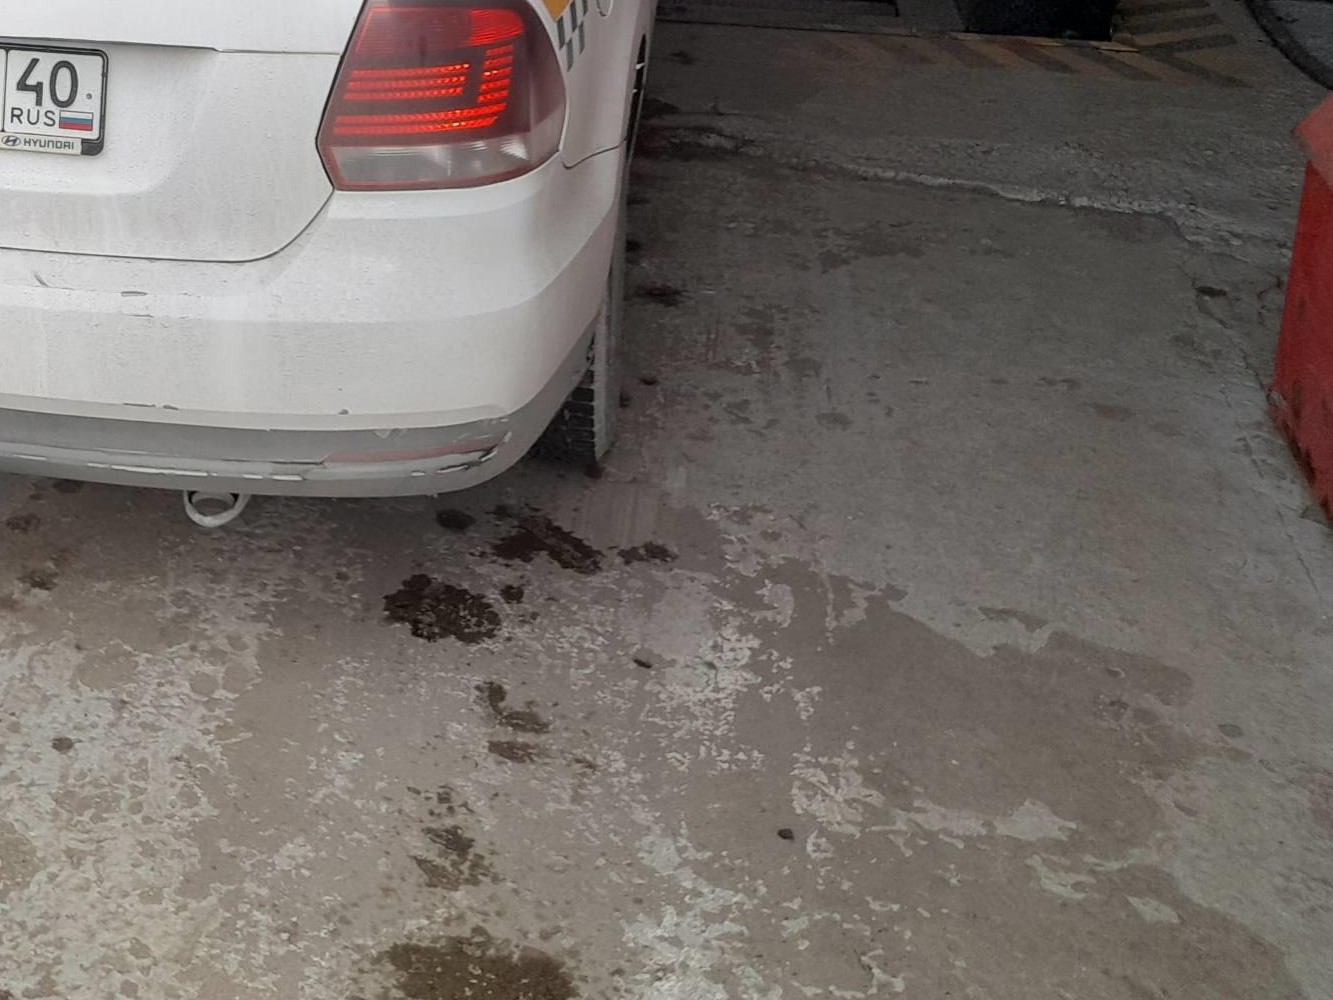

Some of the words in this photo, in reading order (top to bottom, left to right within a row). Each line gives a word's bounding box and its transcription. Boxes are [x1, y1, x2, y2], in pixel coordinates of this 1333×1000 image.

[16, 58, 78, 108] 40
[10, 107, 56, 127] RUS
[23, 138, 74, 149] HYUNDAI
